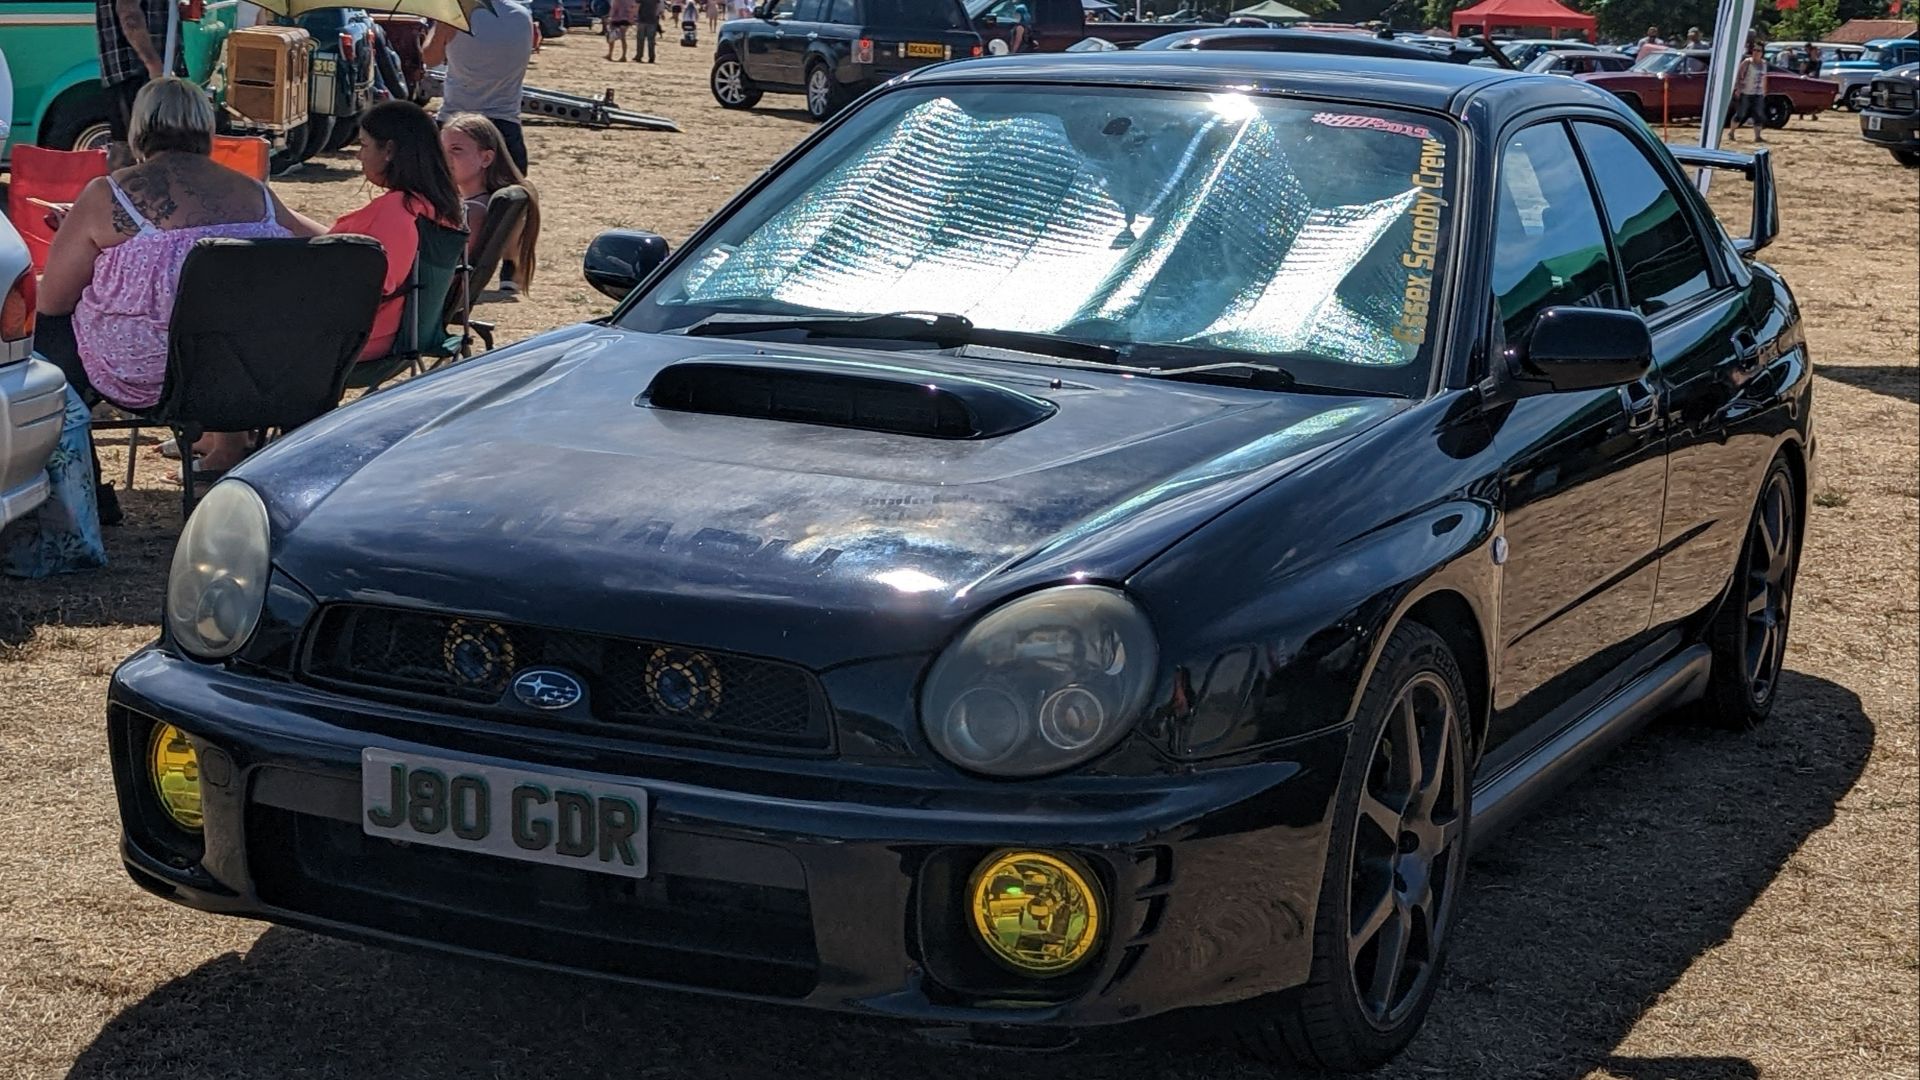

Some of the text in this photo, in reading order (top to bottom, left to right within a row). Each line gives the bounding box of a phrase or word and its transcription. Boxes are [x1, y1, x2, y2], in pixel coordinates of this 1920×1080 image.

[1393, 138, 1448, 345] Essex Scooby Crew
[511, 783, 640, 866] GDR
